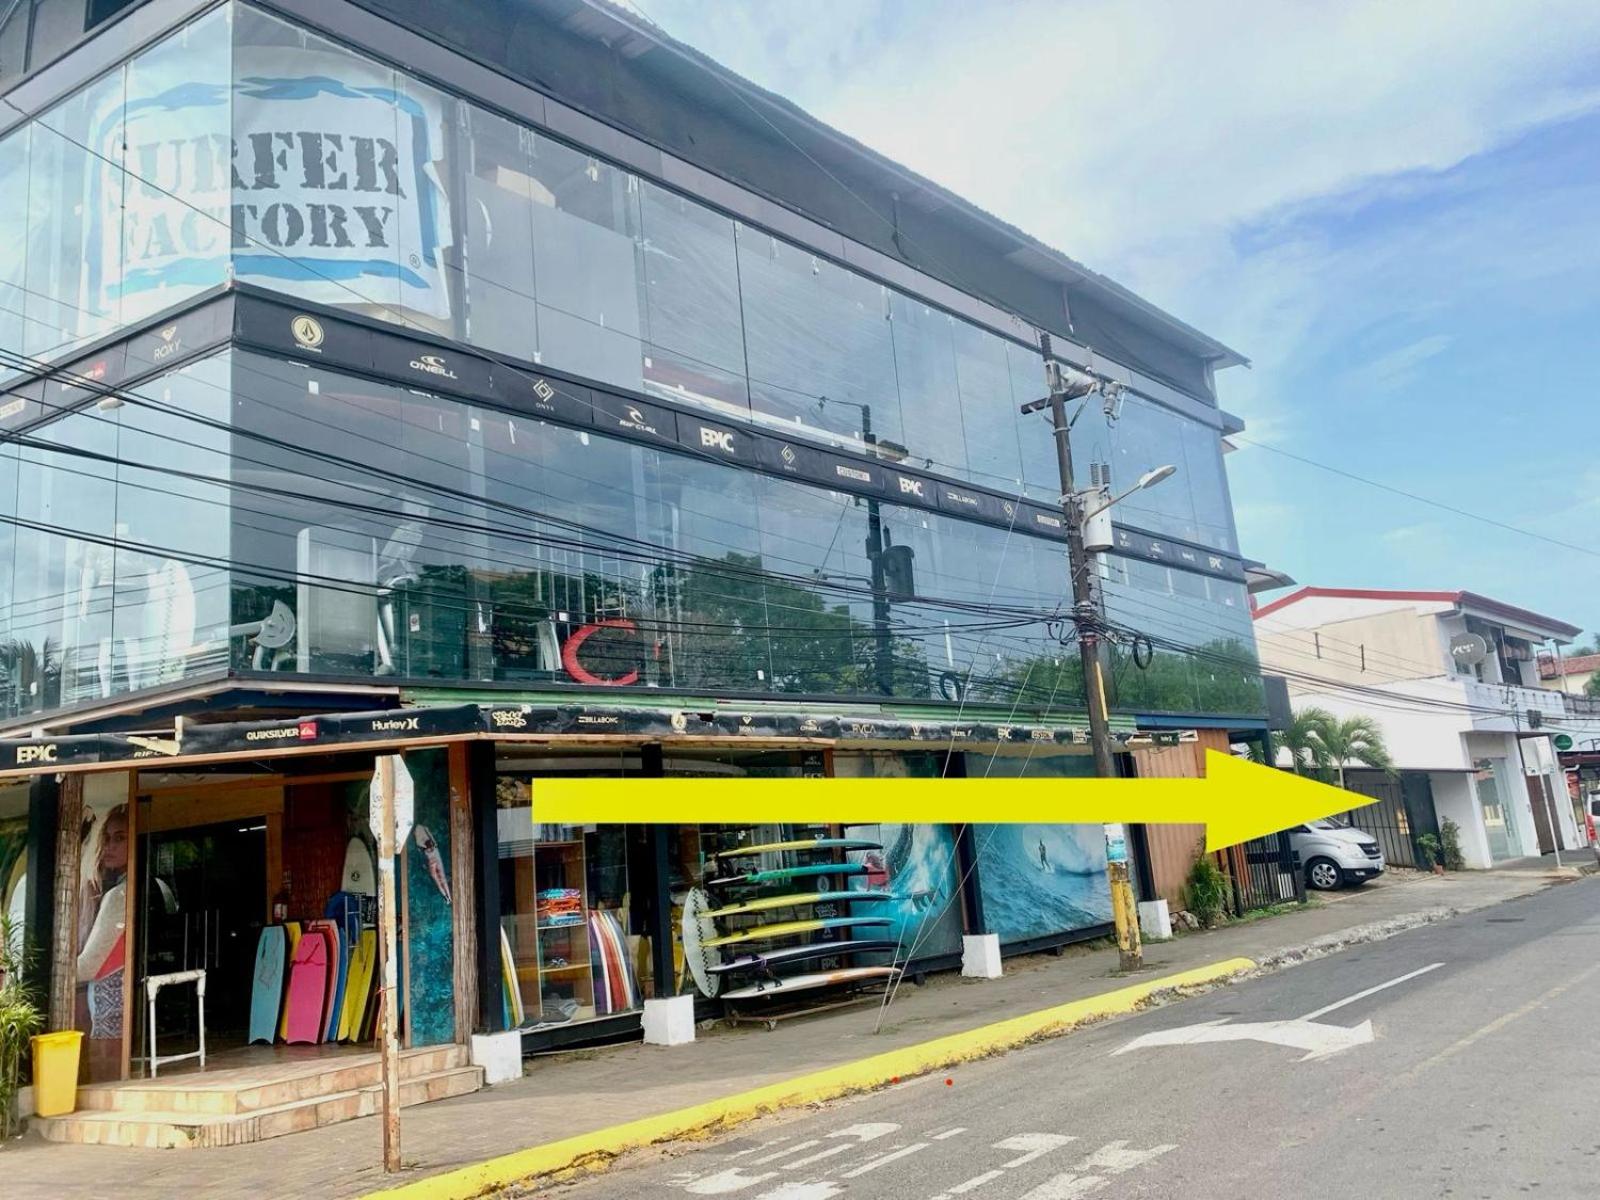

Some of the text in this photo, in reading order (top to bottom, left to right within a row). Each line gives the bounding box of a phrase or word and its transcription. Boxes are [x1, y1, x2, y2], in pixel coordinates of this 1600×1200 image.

[111, 130, 407, 201] SURFER
[116, 202, 393, 265] FACTORY
[154, 338, 182, 361] ROXY
[700, 427, 735, 453] EPIC
[246, 727, 300, 741] QUIKSILVER
[372, 720, 407, 731] Hurley
[16, 744, 58, 765] EPIC
